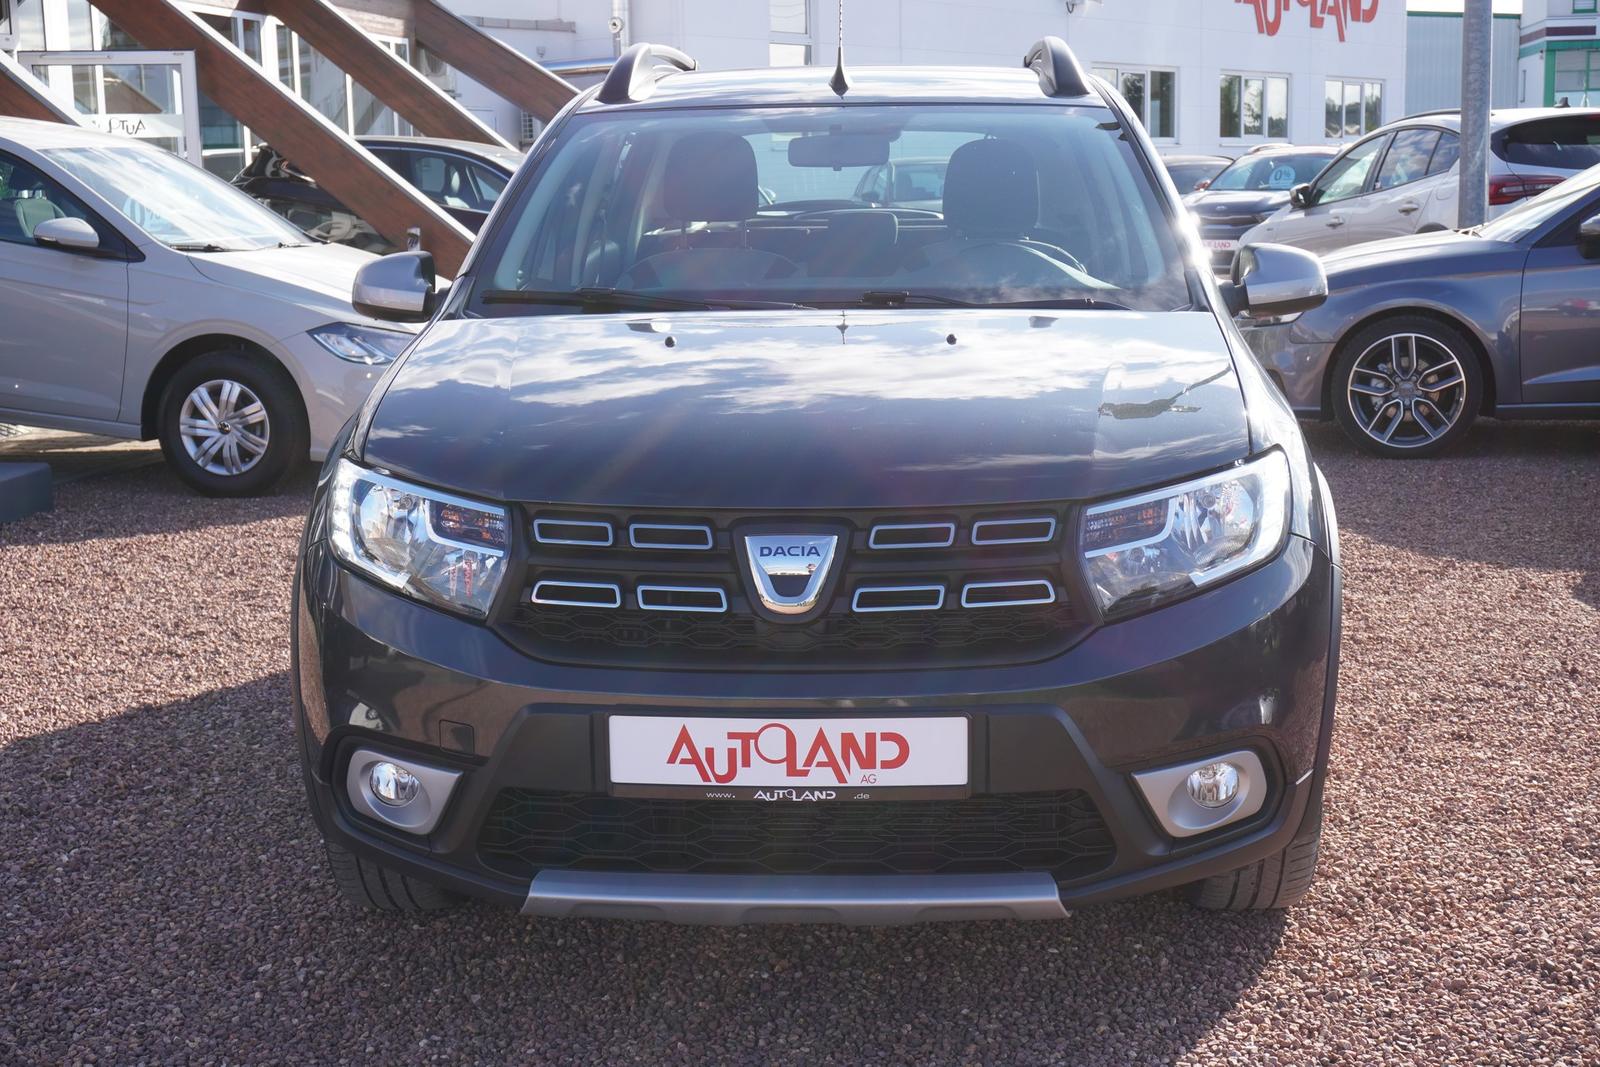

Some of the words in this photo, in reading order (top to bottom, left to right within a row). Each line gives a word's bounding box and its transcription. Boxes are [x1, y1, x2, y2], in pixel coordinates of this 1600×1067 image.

[759, 546, 821, 557] DACIA
[666, 722, 910, 784] AUTOLAND
[860, 773, 877, 784] AG
[753, 788, 837, 802] AUTOLAND
[853, 792, 870, 800] .de
